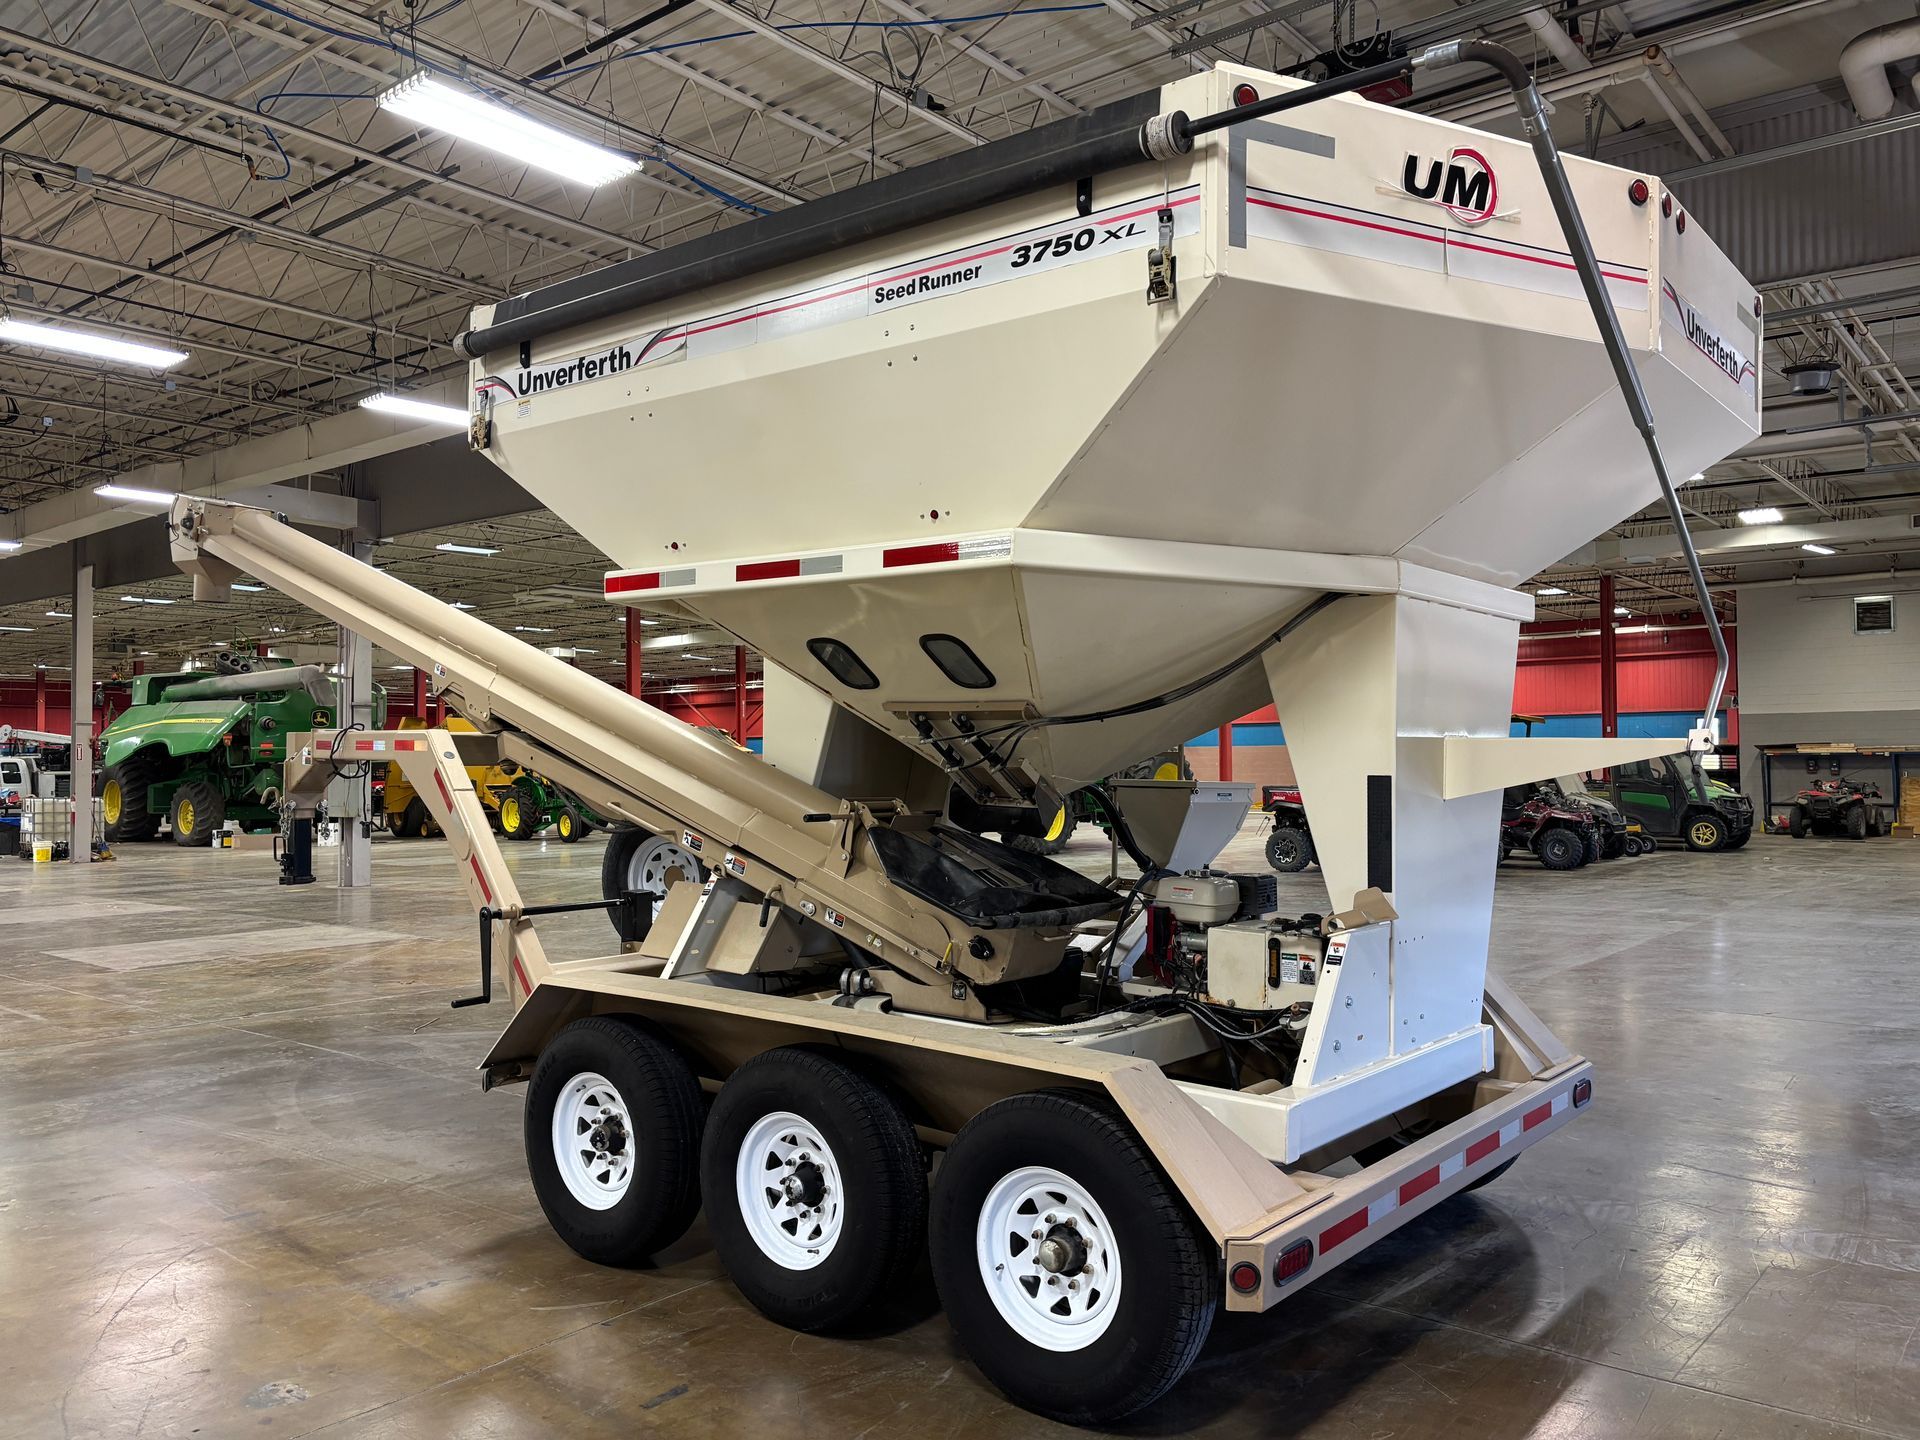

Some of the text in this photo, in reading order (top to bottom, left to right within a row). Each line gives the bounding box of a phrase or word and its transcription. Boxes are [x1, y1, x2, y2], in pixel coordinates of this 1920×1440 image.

[1404, 154, 1490, 212] UM
[1010, 228, 1096, 268] 3750
[1098, 222, 1147, 245] XL
[518, 346, 631, 396] Unverferth
[1687, 308, 1739, 380] Unverferth
